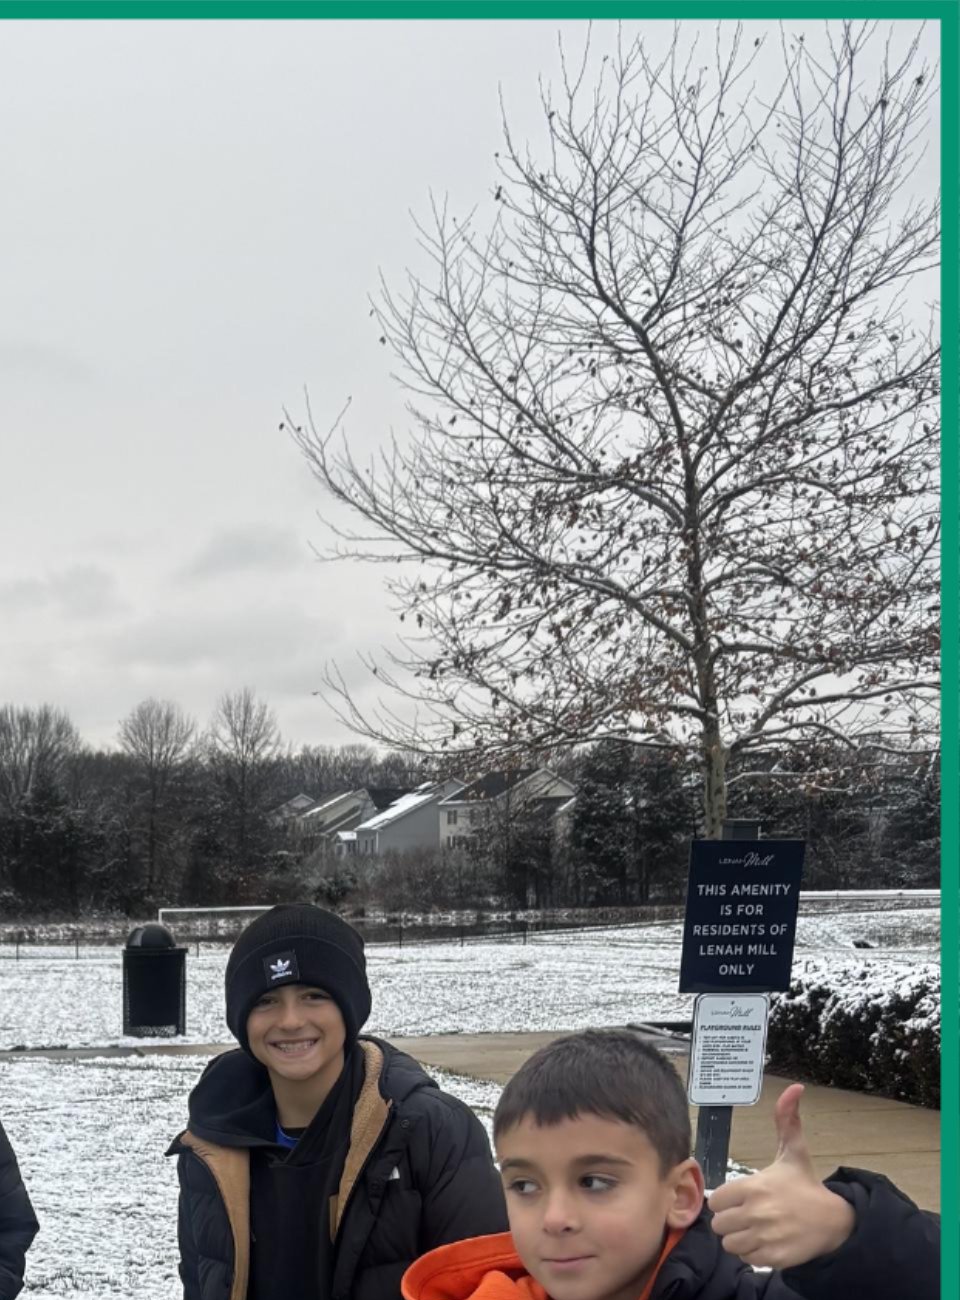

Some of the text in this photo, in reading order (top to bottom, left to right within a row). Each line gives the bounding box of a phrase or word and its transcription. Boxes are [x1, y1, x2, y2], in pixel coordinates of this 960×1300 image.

[697, 884, 791, 896] THIS AMENITY
[720, 904, 764, 916] IS FOR
[692, 923, 788, 936] RESIDENTS OF
[699, 943, 777, 956] LENAH MILL
[718, 964, 755, 976] ONLY
